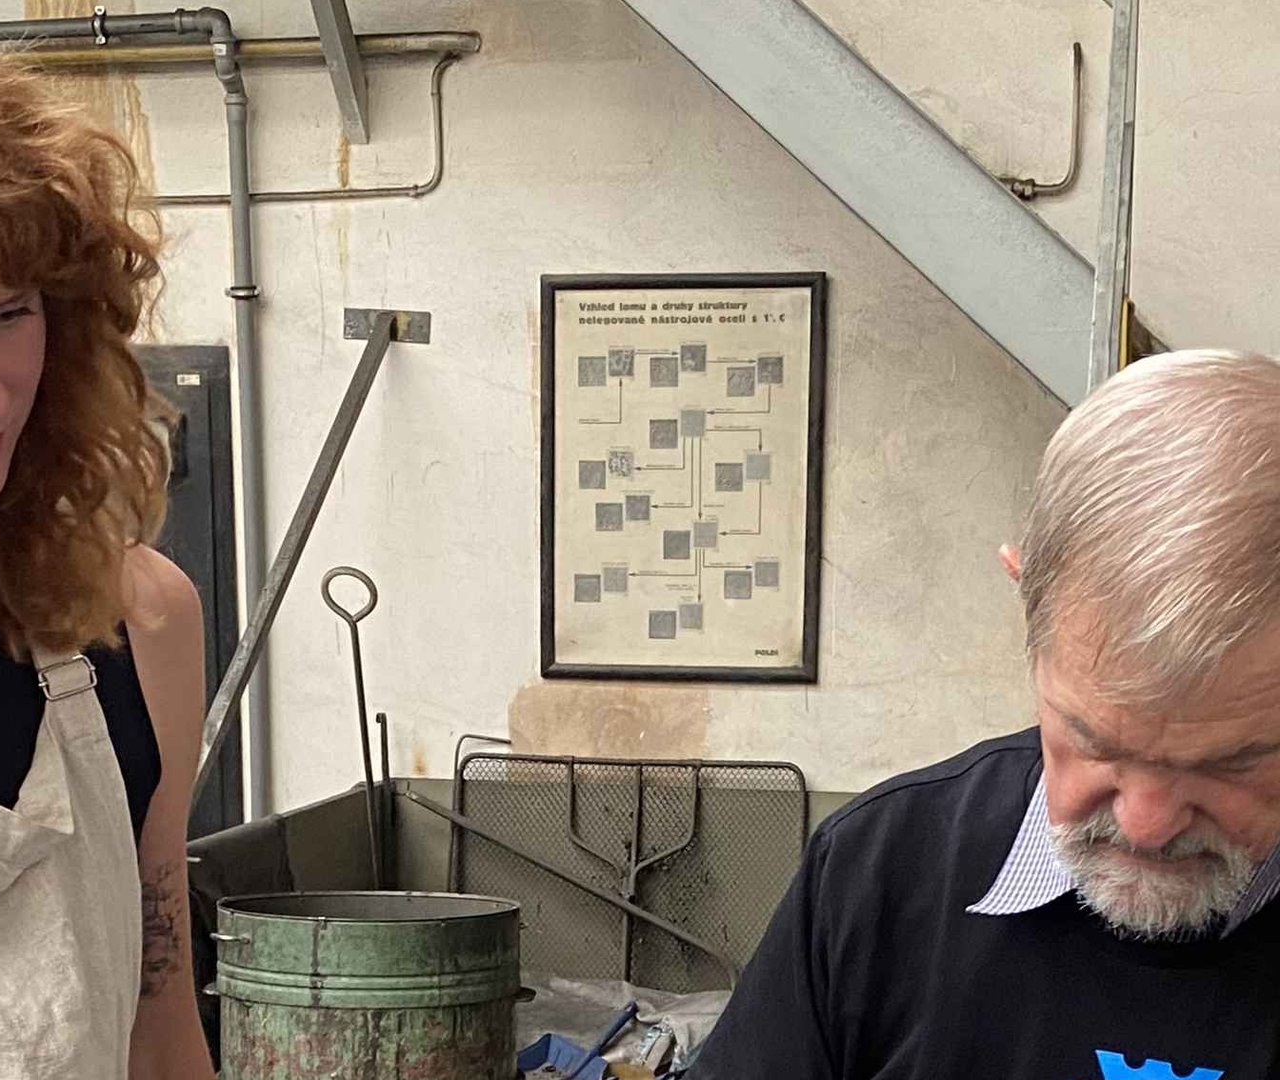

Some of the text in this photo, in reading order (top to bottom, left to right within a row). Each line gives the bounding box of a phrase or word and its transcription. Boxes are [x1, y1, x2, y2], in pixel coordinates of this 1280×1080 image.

[651, 303, 658, 311] a
[662, 301, 694, 312] druhy
[698, 301, 748, 311] struktury
